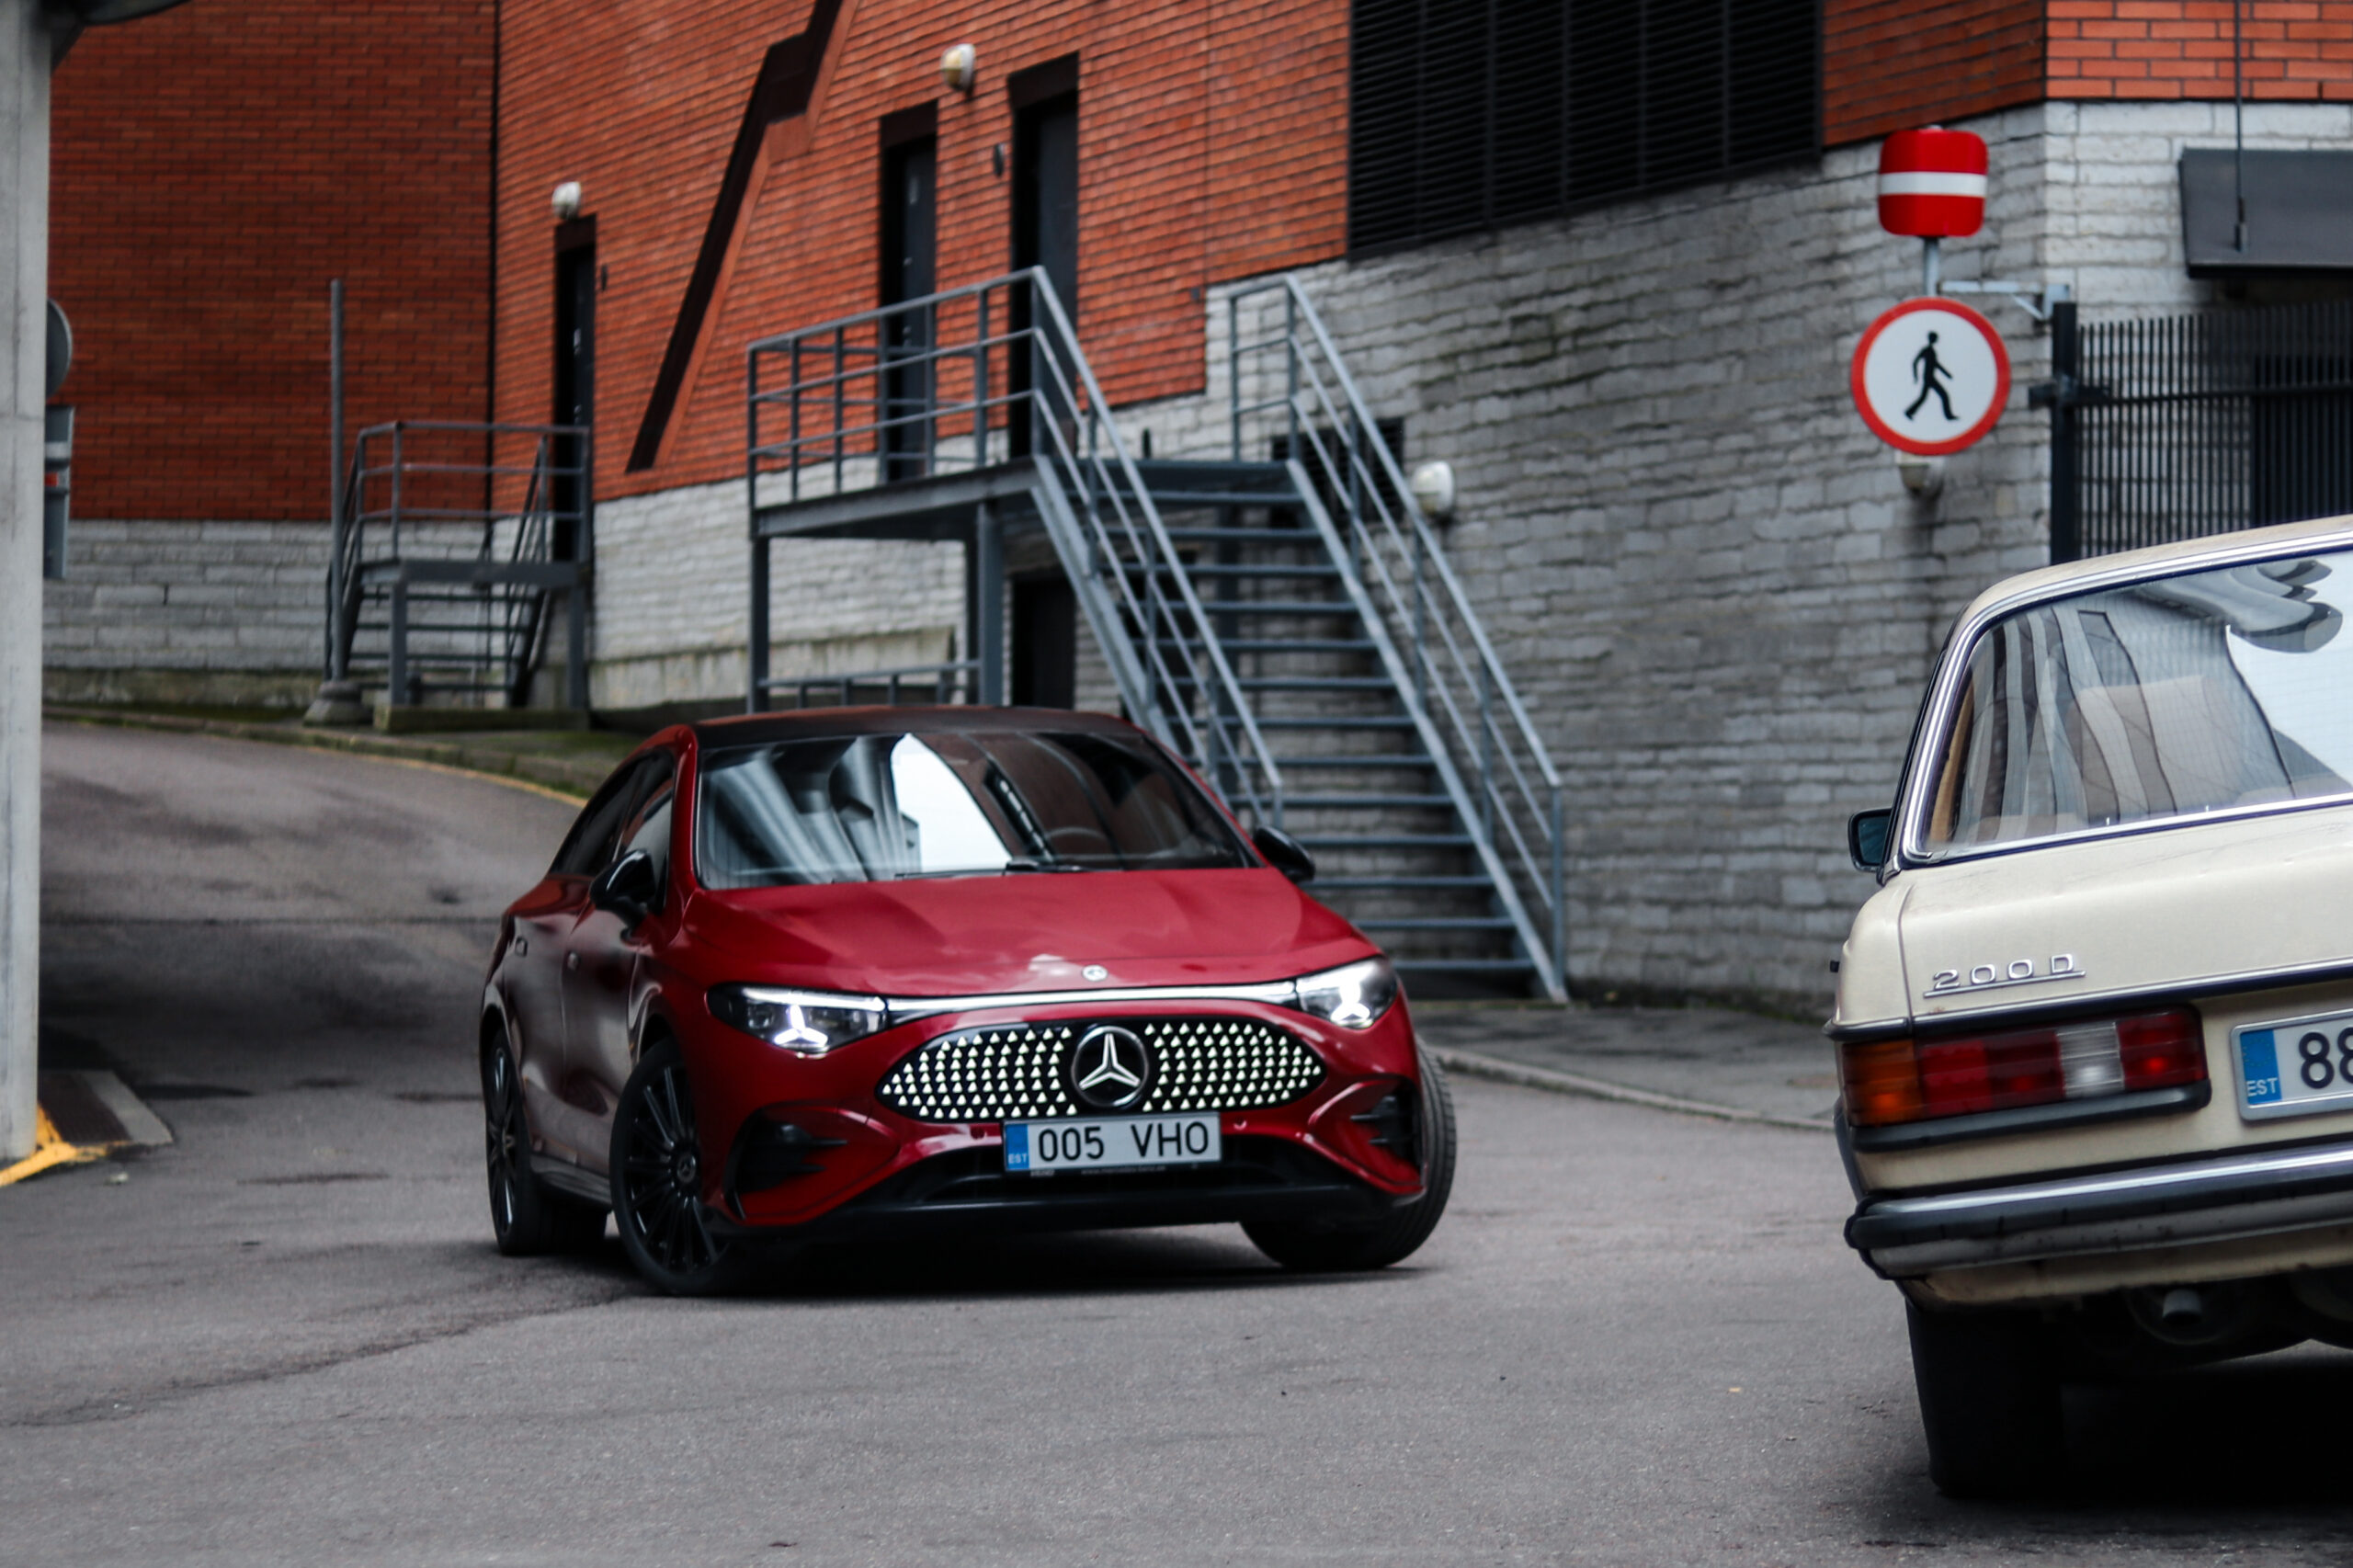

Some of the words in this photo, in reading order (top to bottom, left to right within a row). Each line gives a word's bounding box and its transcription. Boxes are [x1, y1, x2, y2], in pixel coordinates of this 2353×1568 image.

[2246, 1077, 2279, 1097] EST
[1039, 1125, 1105, 1163] 005
[1131, 1121, 1210, 1158] VHO
[1007, 1153, 1028, 1165] EST
